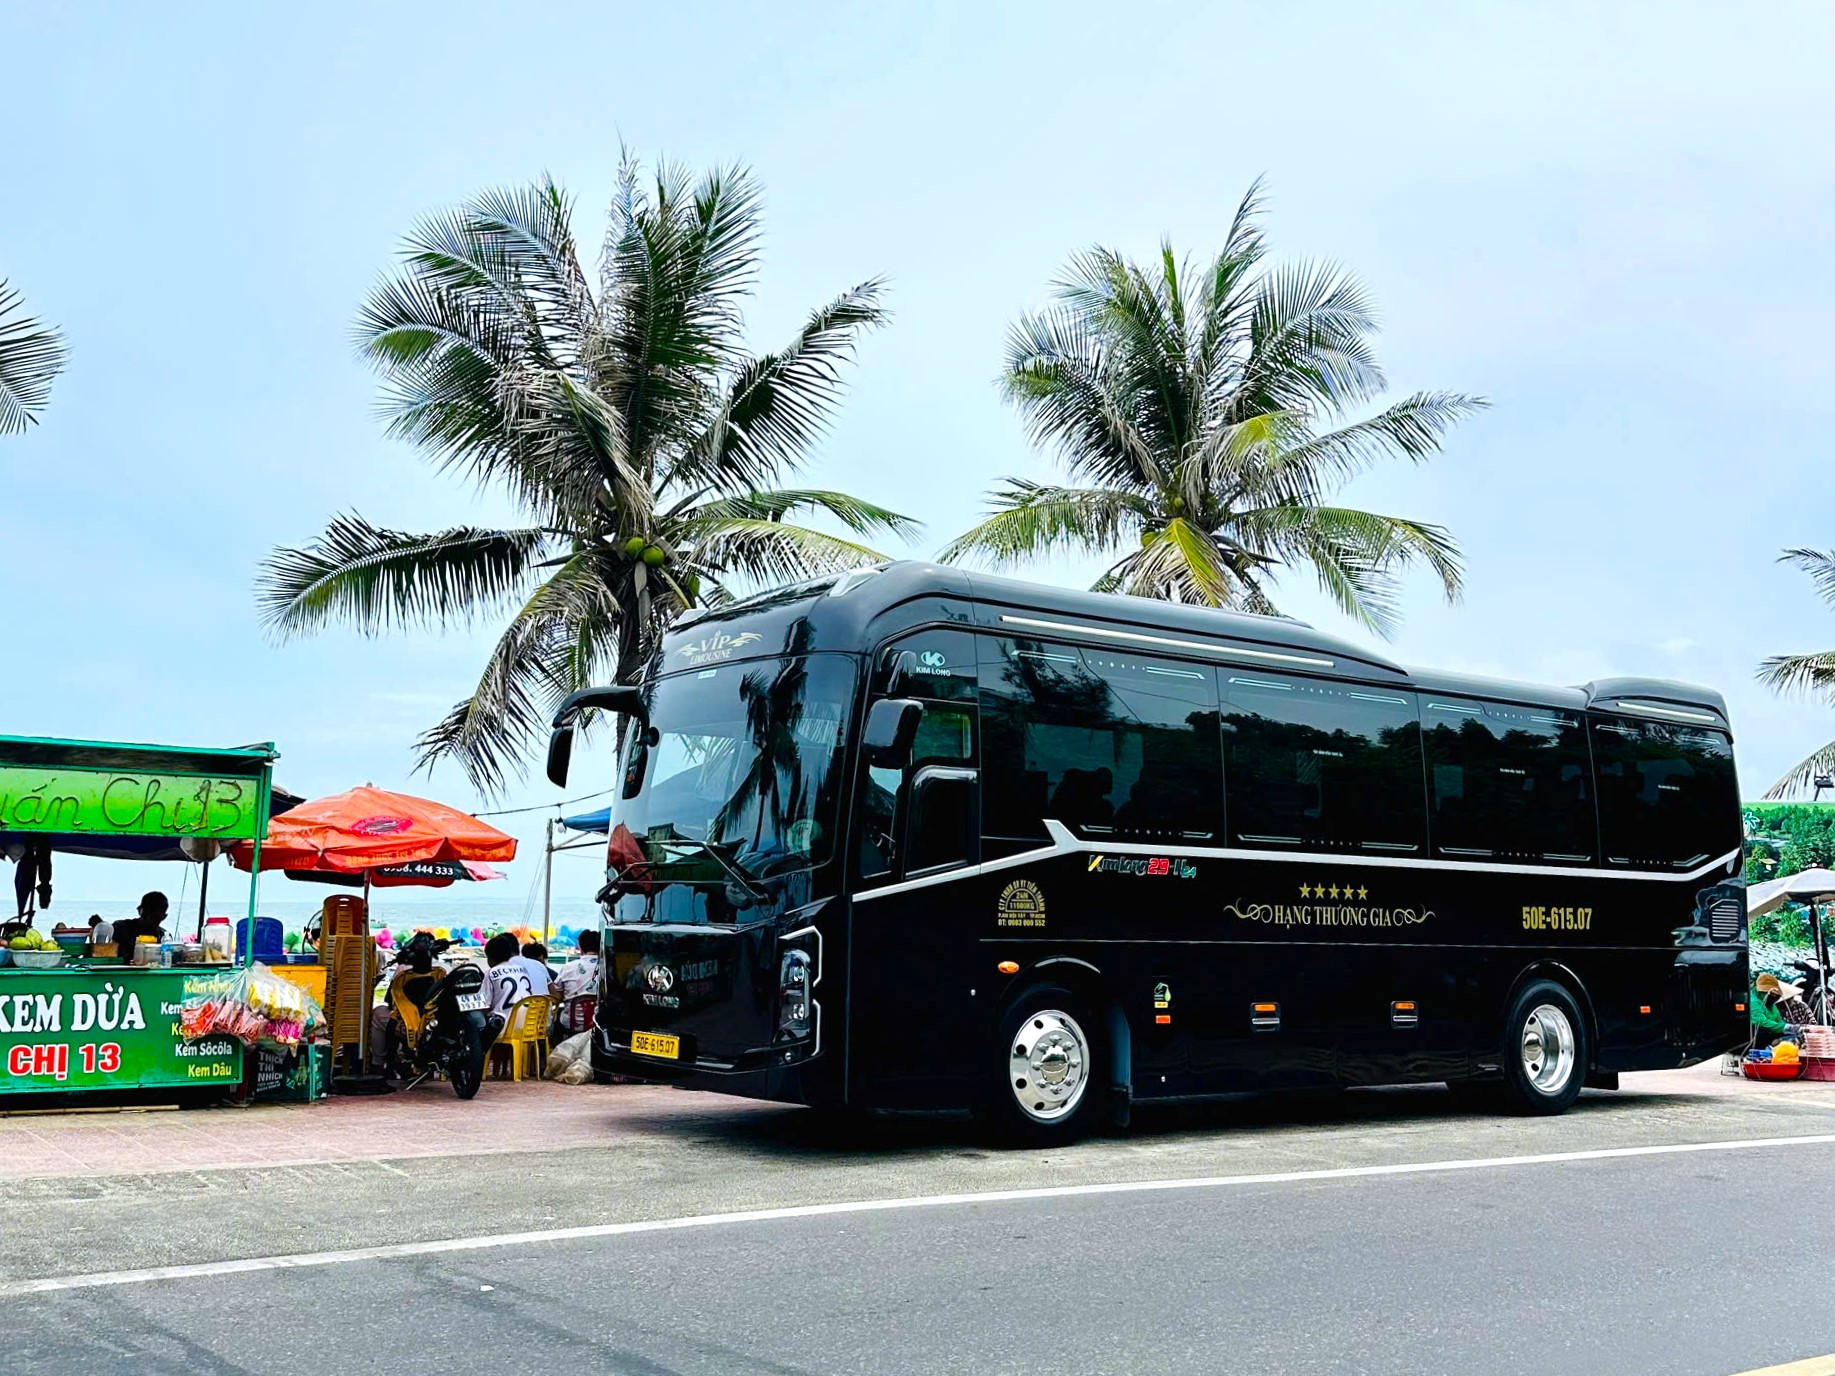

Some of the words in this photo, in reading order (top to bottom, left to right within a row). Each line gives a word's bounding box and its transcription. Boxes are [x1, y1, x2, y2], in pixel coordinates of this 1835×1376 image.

[700, 635, 731, 652] VIP
[689, 648, 733, 665] LIMOUSINE
[916, 666, 931, 675] KIM
[931, 668, 951, 677] LONG
[415, 864, 434, 876] 444
[435, 868, 454, 877] 333
[1274, 904, 1311, 930] HẠNG
[1314, 904, 1367, 927] THƯƠNG
[1370, 908, 1392, 927] GIA
[1522, 906, 1593, 930] 50E-615.07
[0, 994, 63, 1032] KEM
[71, 982, 146, 1031] DỪA
[175, 1043, 198, 1057] Kem
[199, 1041, 233, 1056] Sôcôla
[635, 1036, 675, 1054] 50E-615.07
[8, 1043, 69, 1080] CHỊ
[79, 1042, 121, 1074] 13
[188, 1064, 210, 1078] Kem
[212, 1062, 232, 1076] Dâu
